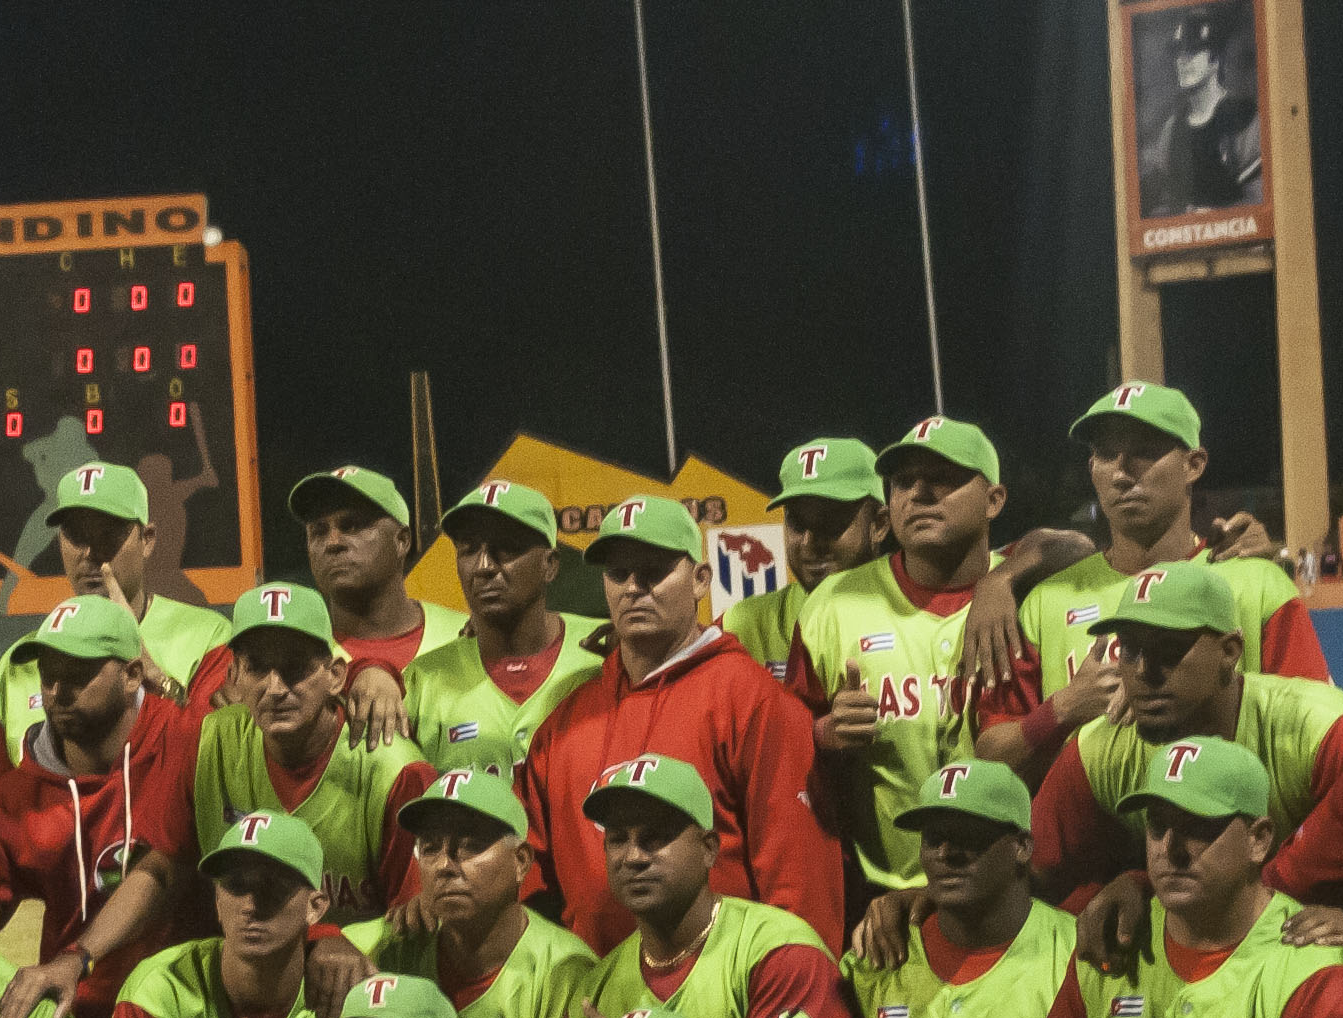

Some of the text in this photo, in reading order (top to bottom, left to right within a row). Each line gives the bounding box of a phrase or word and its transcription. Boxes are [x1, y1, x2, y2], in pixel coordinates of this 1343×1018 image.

[1143, 216, 1258, 248] CONSTANCIA
[59, 245, 187, 272] C H E
[74, 282, 194, 313] 0 0 0
[76, 344, 197, 373] 0 0 0
[6, 388, 18, 408] S
[86, 384, 100, 404] B
[1113, 382, 1144, 409] T
[6, 402, 186, 437] 0 0 0
[914, 417, 943, 441] T
[798, 445, 827, 478] T
[76, 466, 104, 495] T
[480, 480, 510, 506] T
[617, 501, 646, 531] T
[1132, 570, 1165, 602] T
[48, 604, 79, 632] T
[260, 588, 291, 622] T
[861, 673, 922, 723] AS
[626, 758, 659, 785] T
[1164, 743, 1201, 781] T
[440, 770, 472, 798] T
[939, 763, 971, 797] T
[240, 814, 271, 845] T
[365, 979, 398, 1007] T
